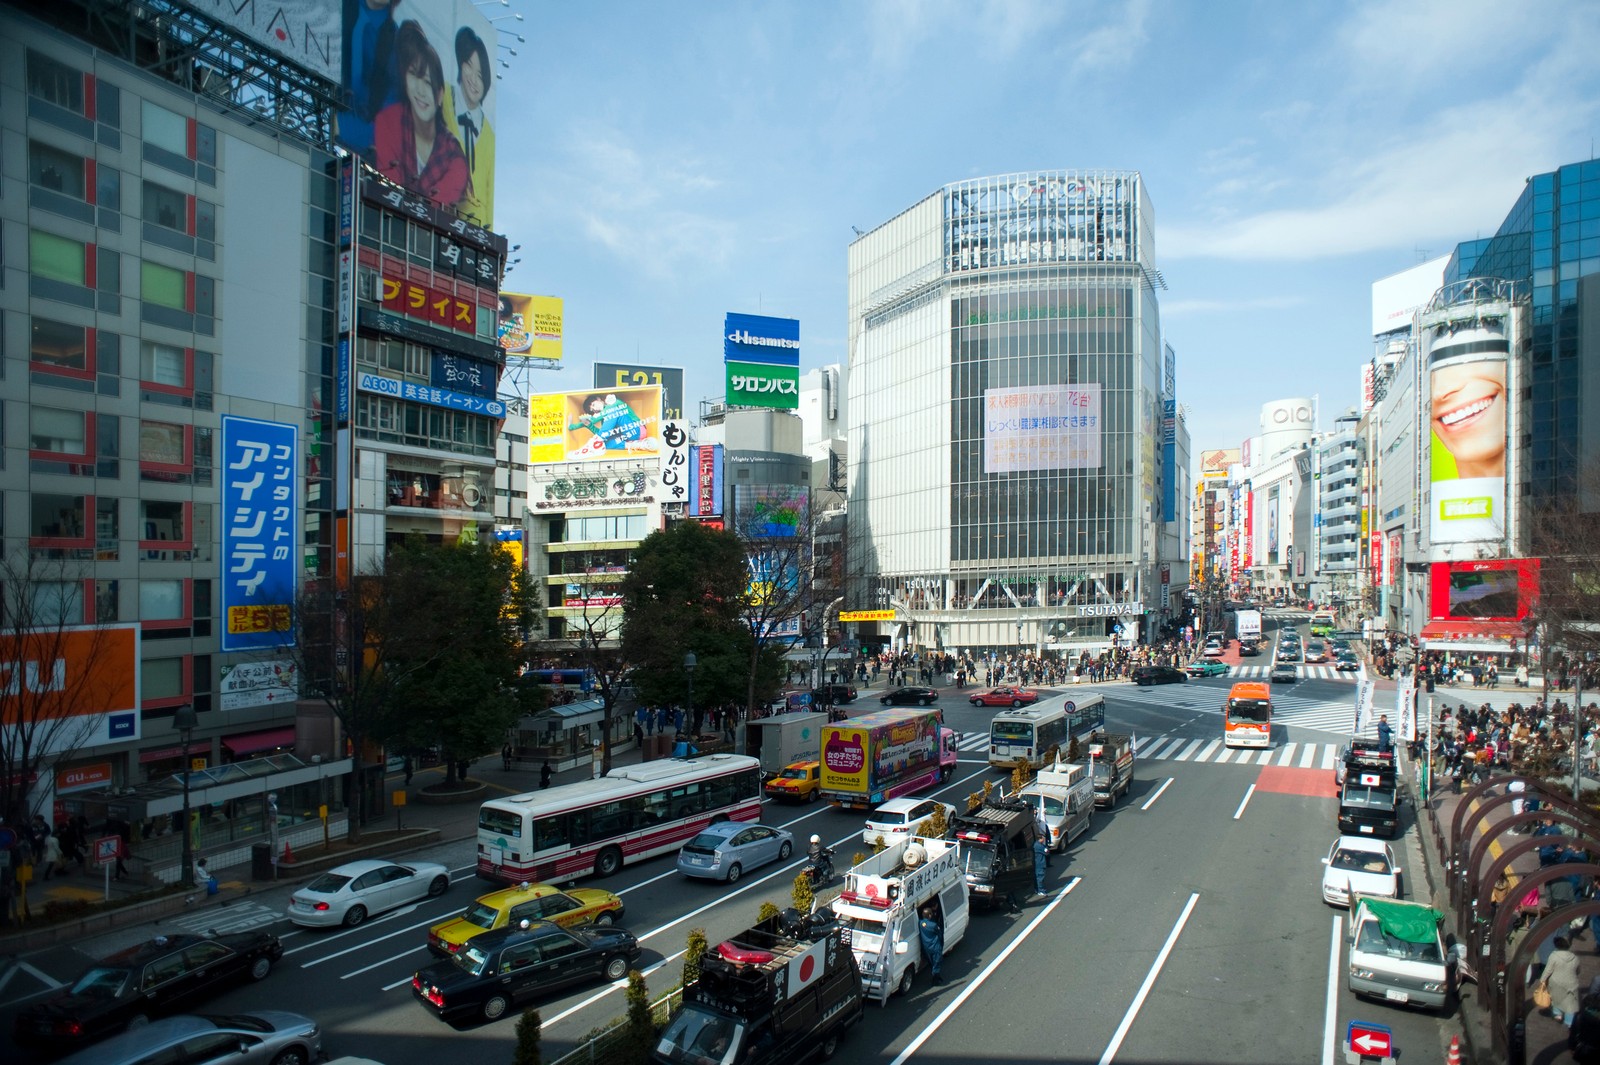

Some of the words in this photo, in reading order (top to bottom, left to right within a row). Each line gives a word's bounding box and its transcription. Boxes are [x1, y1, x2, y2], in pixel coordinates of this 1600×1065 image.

[534, 325, 561, 334] XYLISH
[728, 330, 799, 349] Hisamitsu
[362, 374, 398, 394] AEON
[731, 375, 797, 395] サロンパス
[404, 383, 484, 411] 英会話イーオン
[532, 427, 563, 436] XYLISH
[663, 422, 687, 498] もんじゃ
[273, 445, 291, 561] コンタクトの
[229, 440, 270, 596] アイシティ
[1080, 604, 1132, 617] TSUTAYA
[827, 751, 862, 761] 女の子たちの
